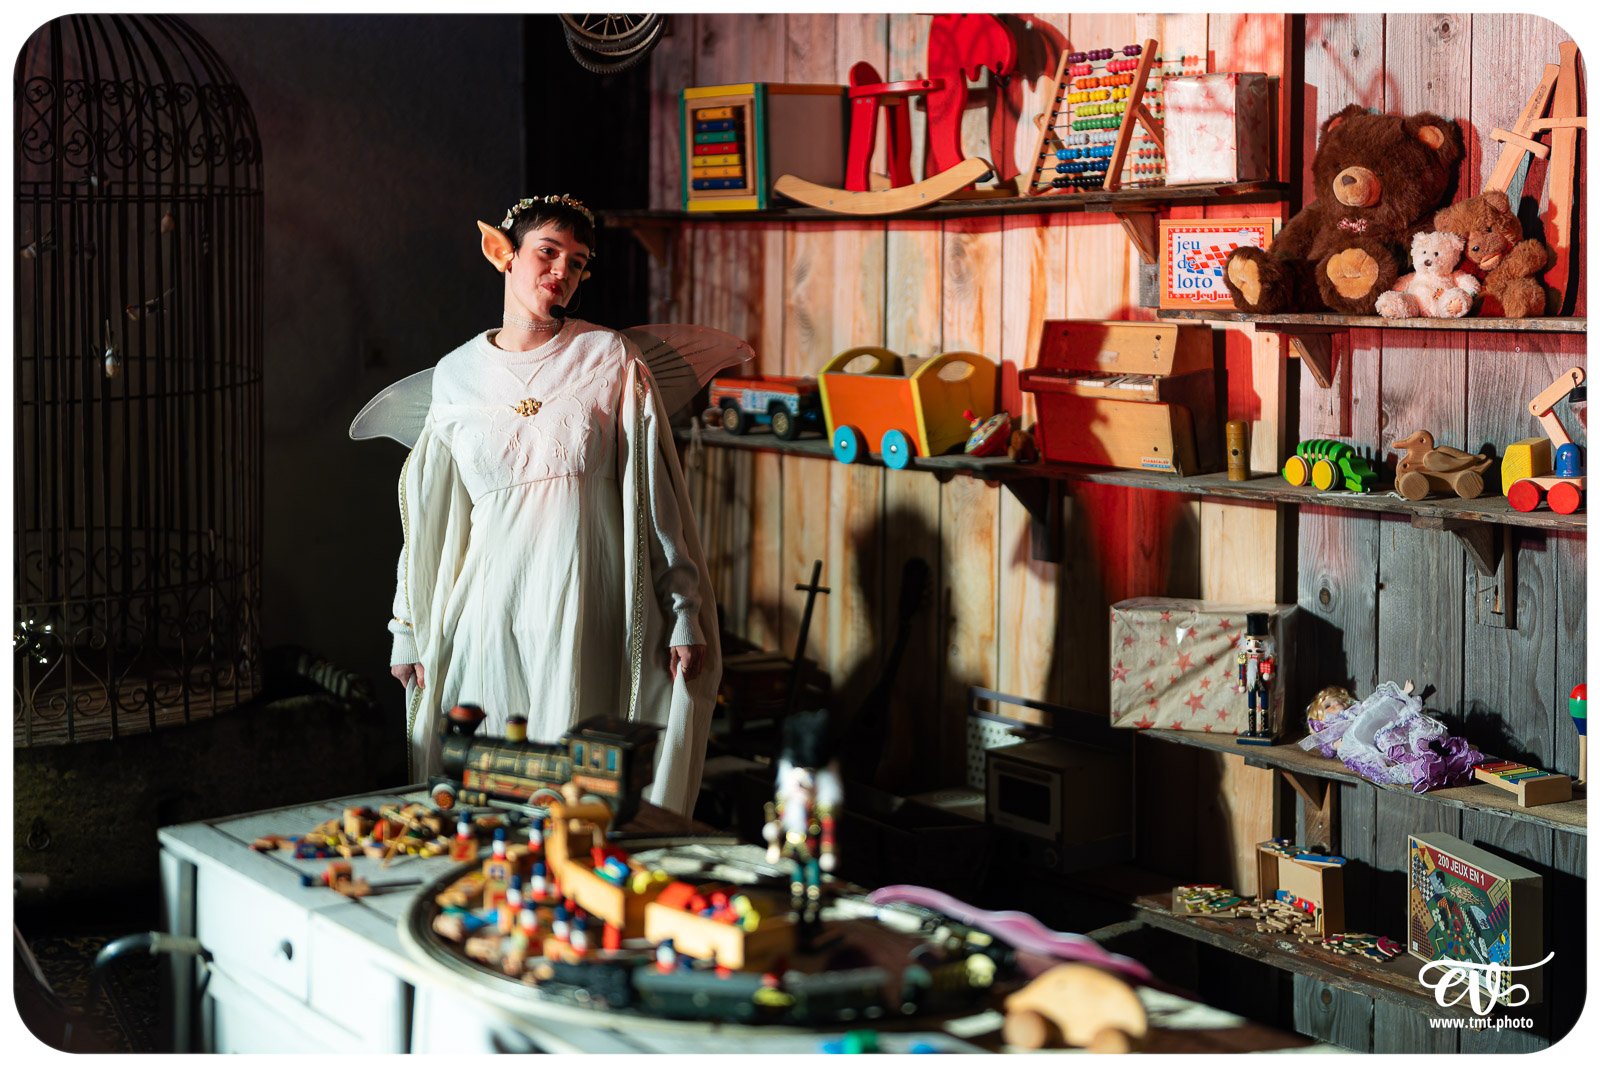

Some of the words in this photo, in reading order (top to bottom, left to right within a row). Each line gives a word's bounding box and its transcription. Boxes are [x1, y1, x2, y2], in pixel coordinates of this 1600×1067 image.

[1176, 235, 1200, 255] jeu
[1177, 254, 1196, 269] de
[1177, 274, 1213, 288] loto
[1438, 854, 1449, 869] 200
[1450, 860, 1468, 878] JEUX
[1469, 868, 1479, 883] EN
[1481, 874, 1485, 886] 1
